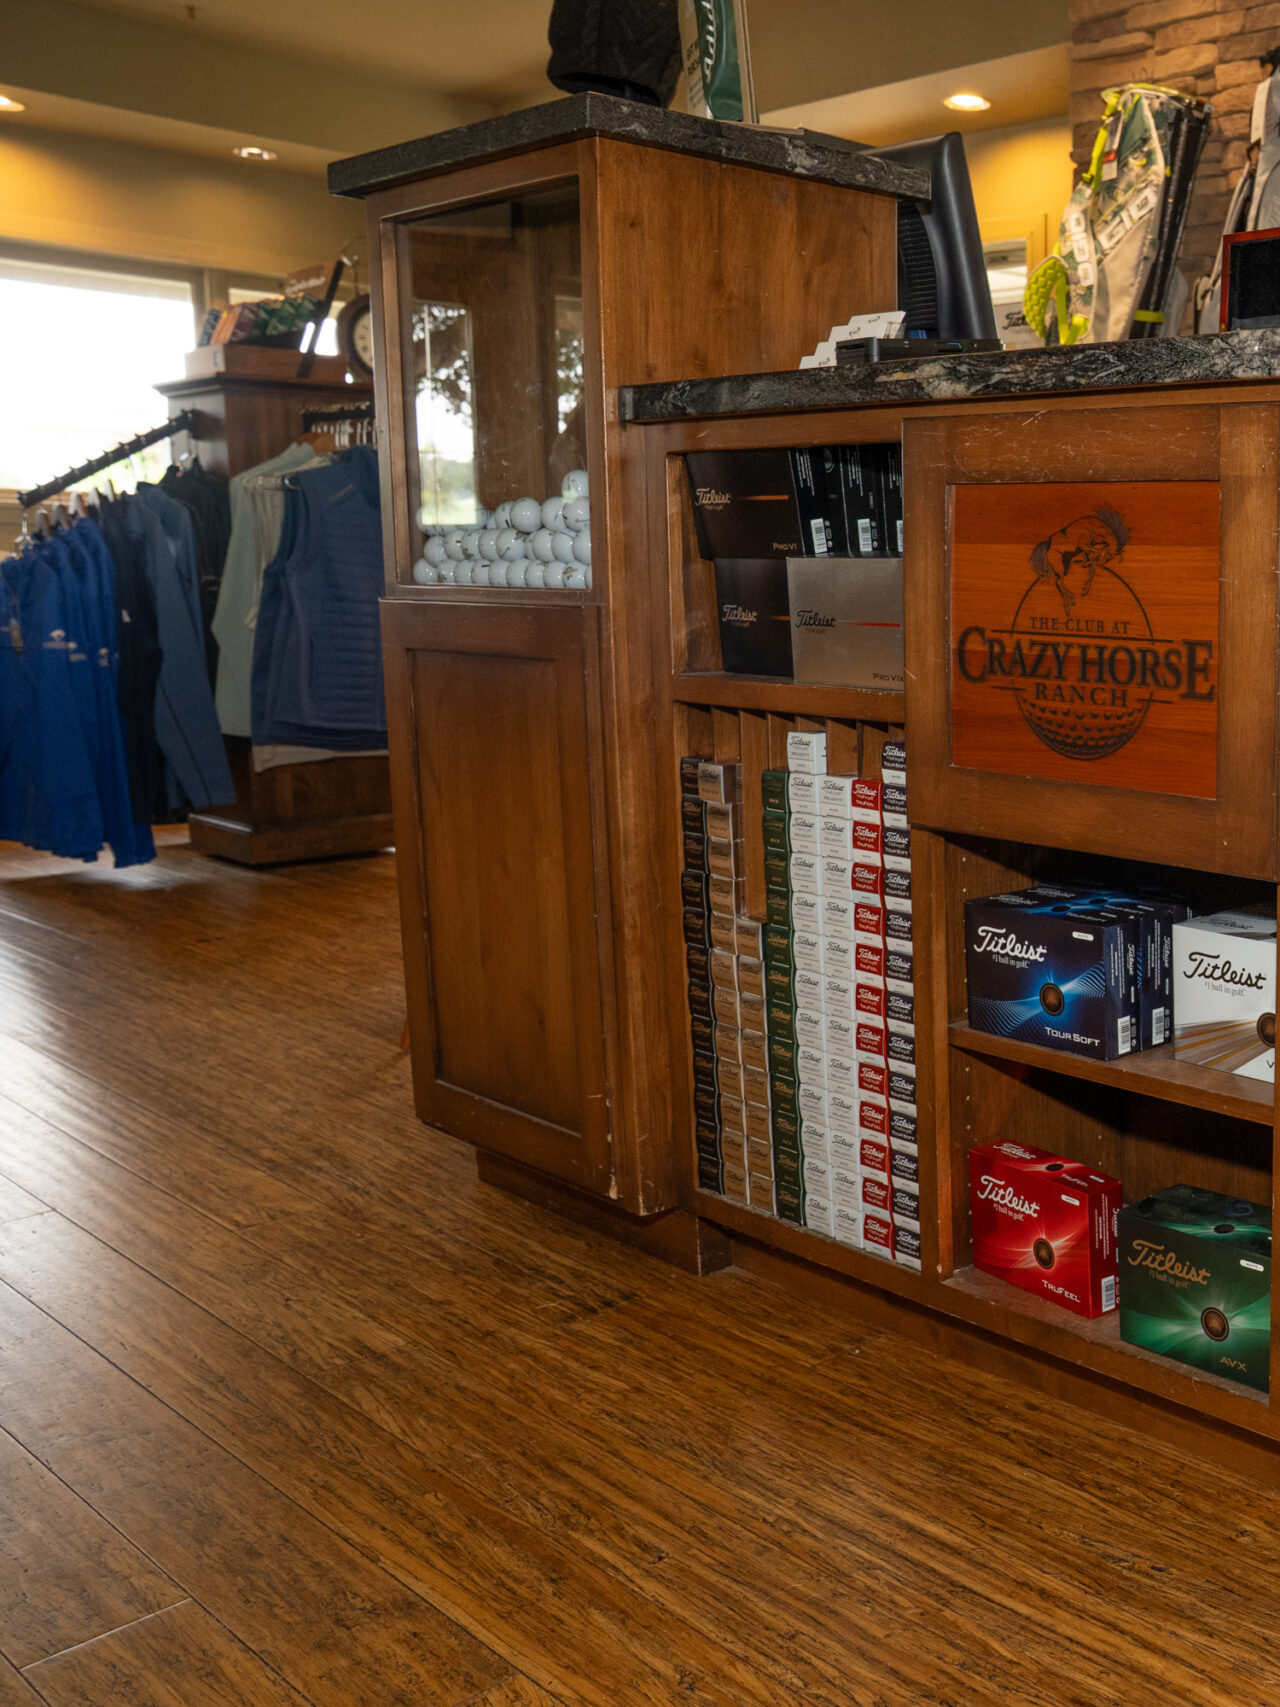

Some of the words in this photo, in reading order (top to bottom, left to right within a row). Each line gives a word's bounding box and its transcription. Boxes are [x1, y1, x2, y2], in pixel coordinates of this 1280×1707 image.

[695, 488, 731, 505] Titleist
[722, 604, 757, 622] Titleist
[796, 610, 836, 628] Titleist
[1030, 616, 1061, 631] THE
[1065, 618, 1104, 633] CLUB
[1111, 621, 1130, 634] AT
[1035, 682, 1128, 708] RANCH
[822, 781, 844, 791] Titleist
[853, 784, 877, 796] Titleist
[855, 826, 877, 838] Titleist
[884, 832, 908, 844] Titleist
[974, 926, 1047, 962] Titleist
[999, 955, 1008, 964] ball
[1183, 952, 1267, 990] Titleist
[1211, 982, 1223, 993] ball
[1224, 986, 1230, 994] in
[1044, 1027, 1072, 1040] TOUR
[1073, 1034, 1100, 1047] SOFT
[977, 1175, 1040, 1217] Titleist
[1128, 1240, 1211, 1285] Titleist
[1042, 1279, 1080, 1303] TRUFEEL
[1219, 1356, 1247, 1372] AVX
